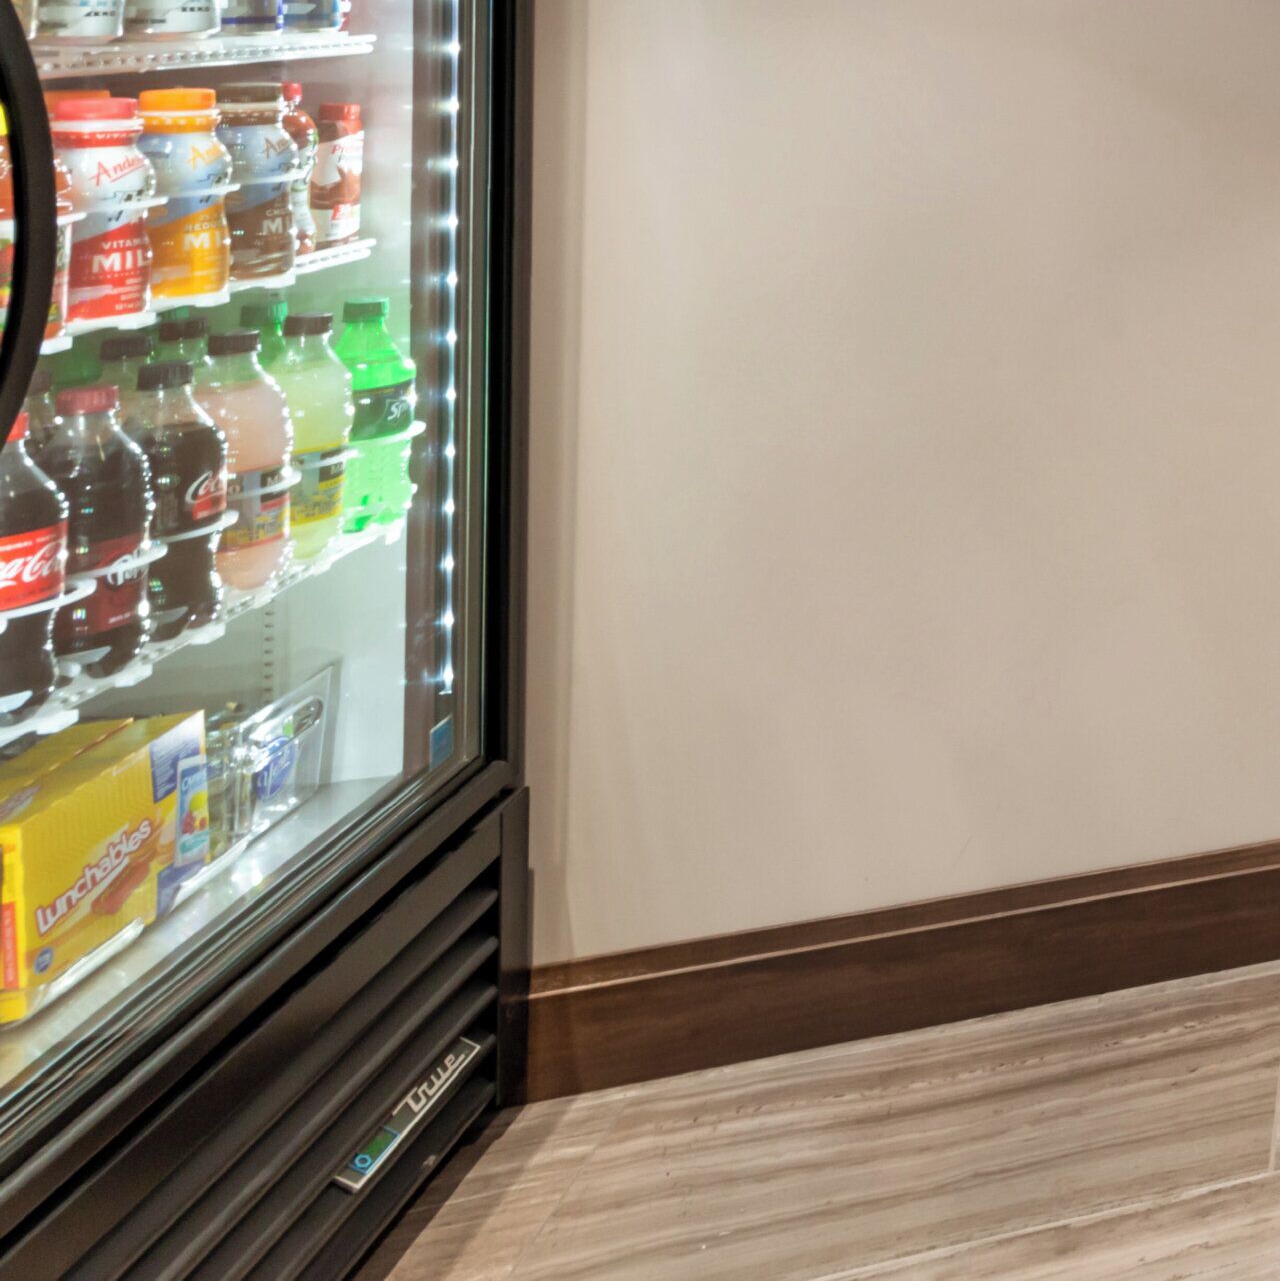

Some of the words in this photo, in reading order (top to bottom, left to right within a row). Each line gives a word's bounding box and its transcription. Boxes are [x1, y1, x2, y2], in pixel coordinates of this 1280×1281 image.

[92, 249, 149, 274] MIL
[36, 819, 151, 936] Lunchables
[392, 1054, 465, 1117] True
